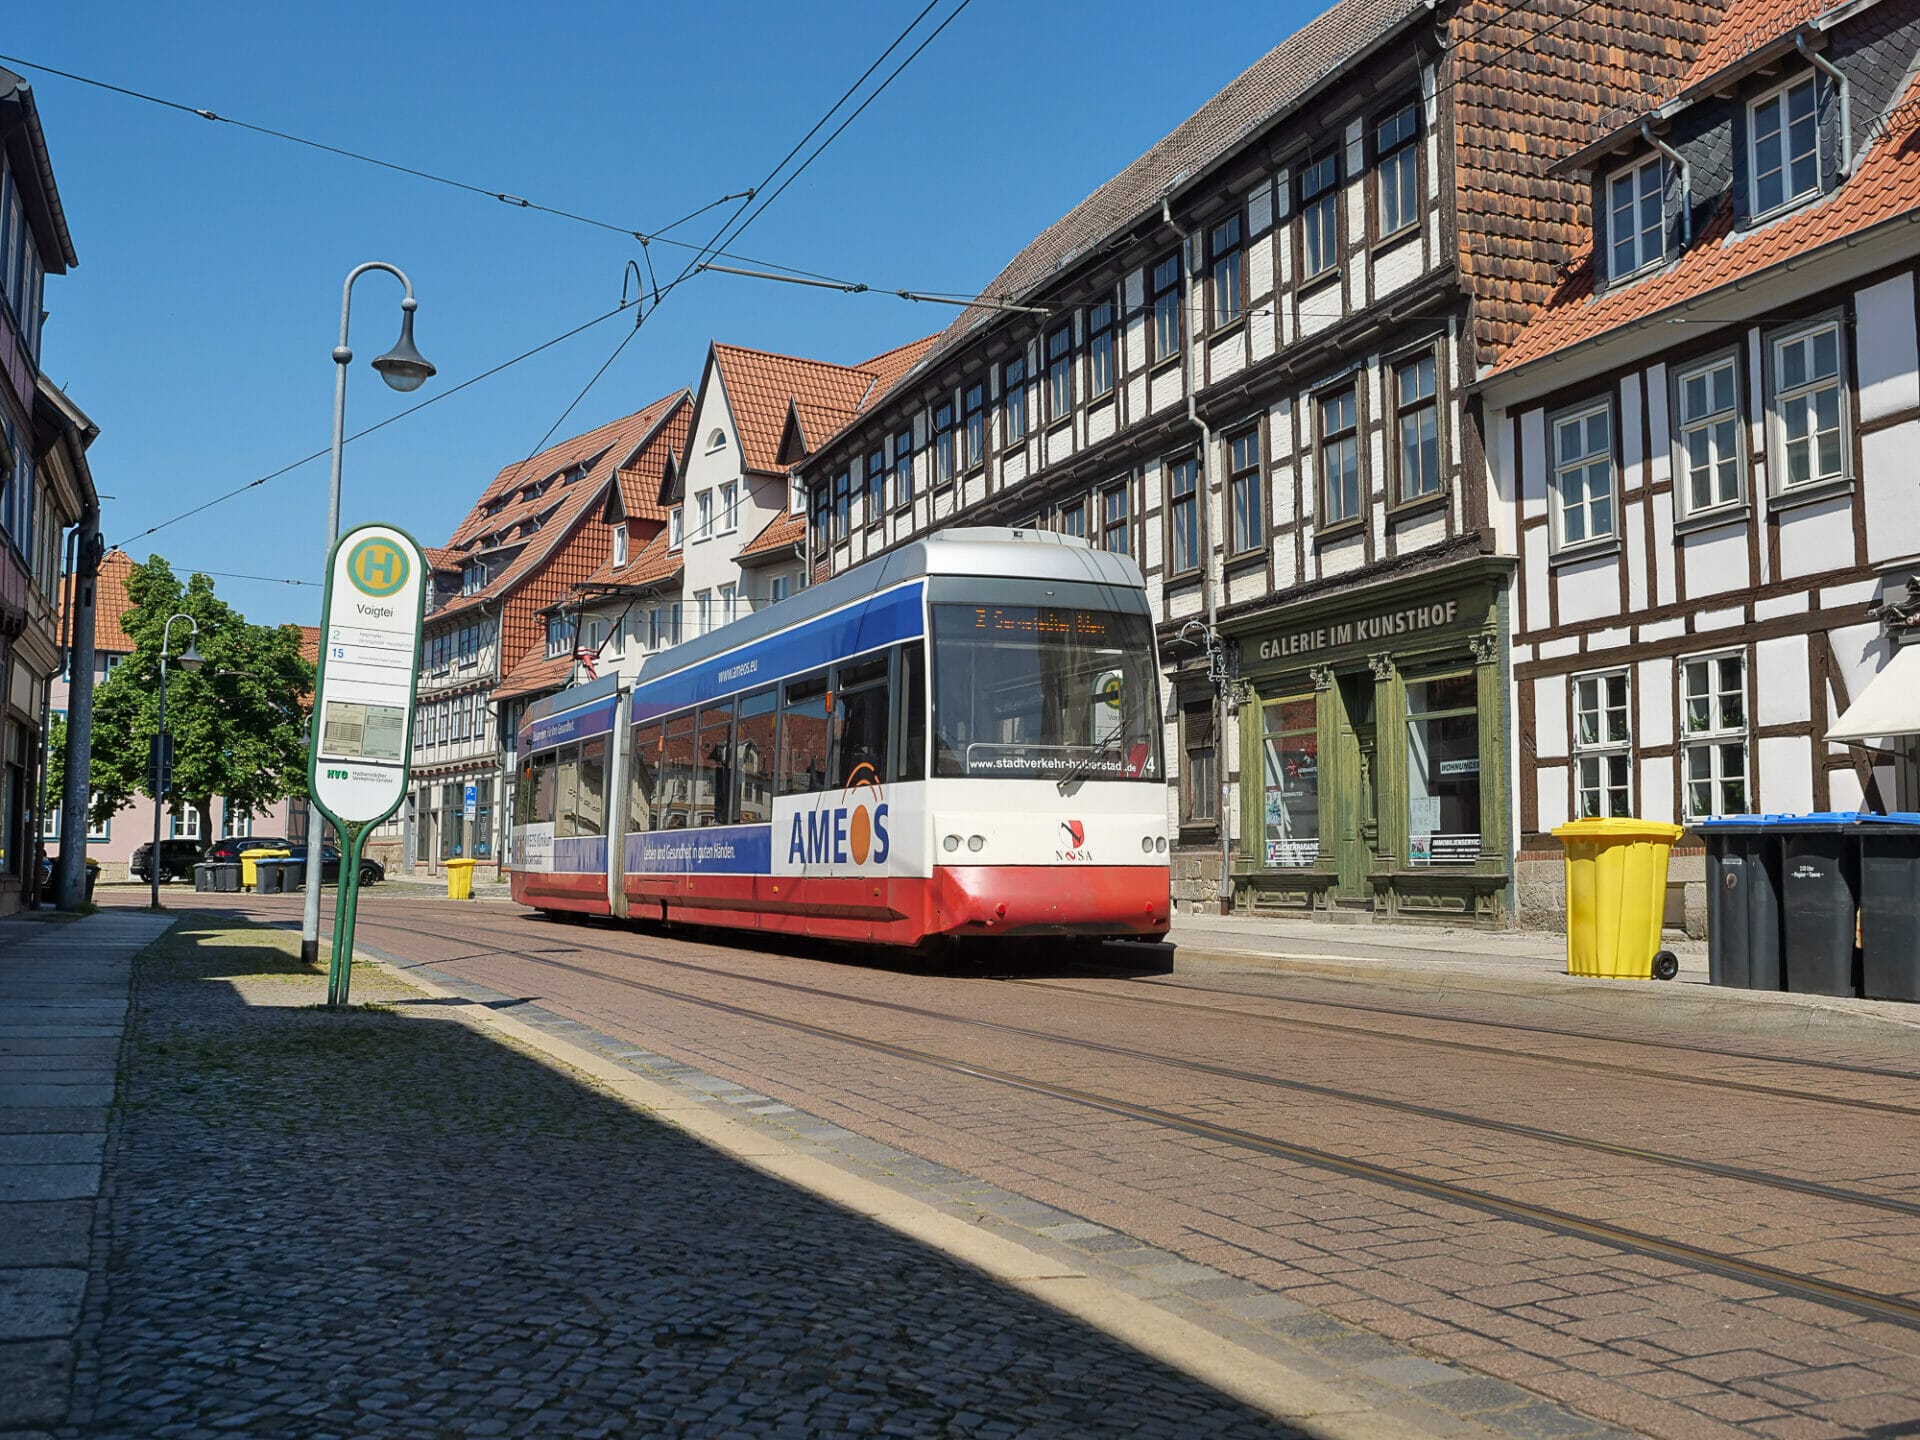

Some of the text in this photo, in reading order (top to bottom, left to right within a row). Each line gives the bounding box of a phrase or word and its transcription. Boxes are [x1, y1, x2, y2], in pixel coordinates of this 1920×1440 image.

[363, 550, 394, 585] H
[357, 603, 394, 619] Voigtei
[332, 630, 341, 640] 2
[1260, 601, 1458, 660] GALERIE IM KUNSTHOF
[332, 648, 344, 659] 15
[718, 659, 758, 684] www.ameos.eu
[970, 754, 1137, 774] www.stadtverkehr-halberstad.de
[1441, 761, 1480, 772] WOHNUNGS
[327, 769, 349, 780] HVG
[788, 803, 889, 866] AMEOS
